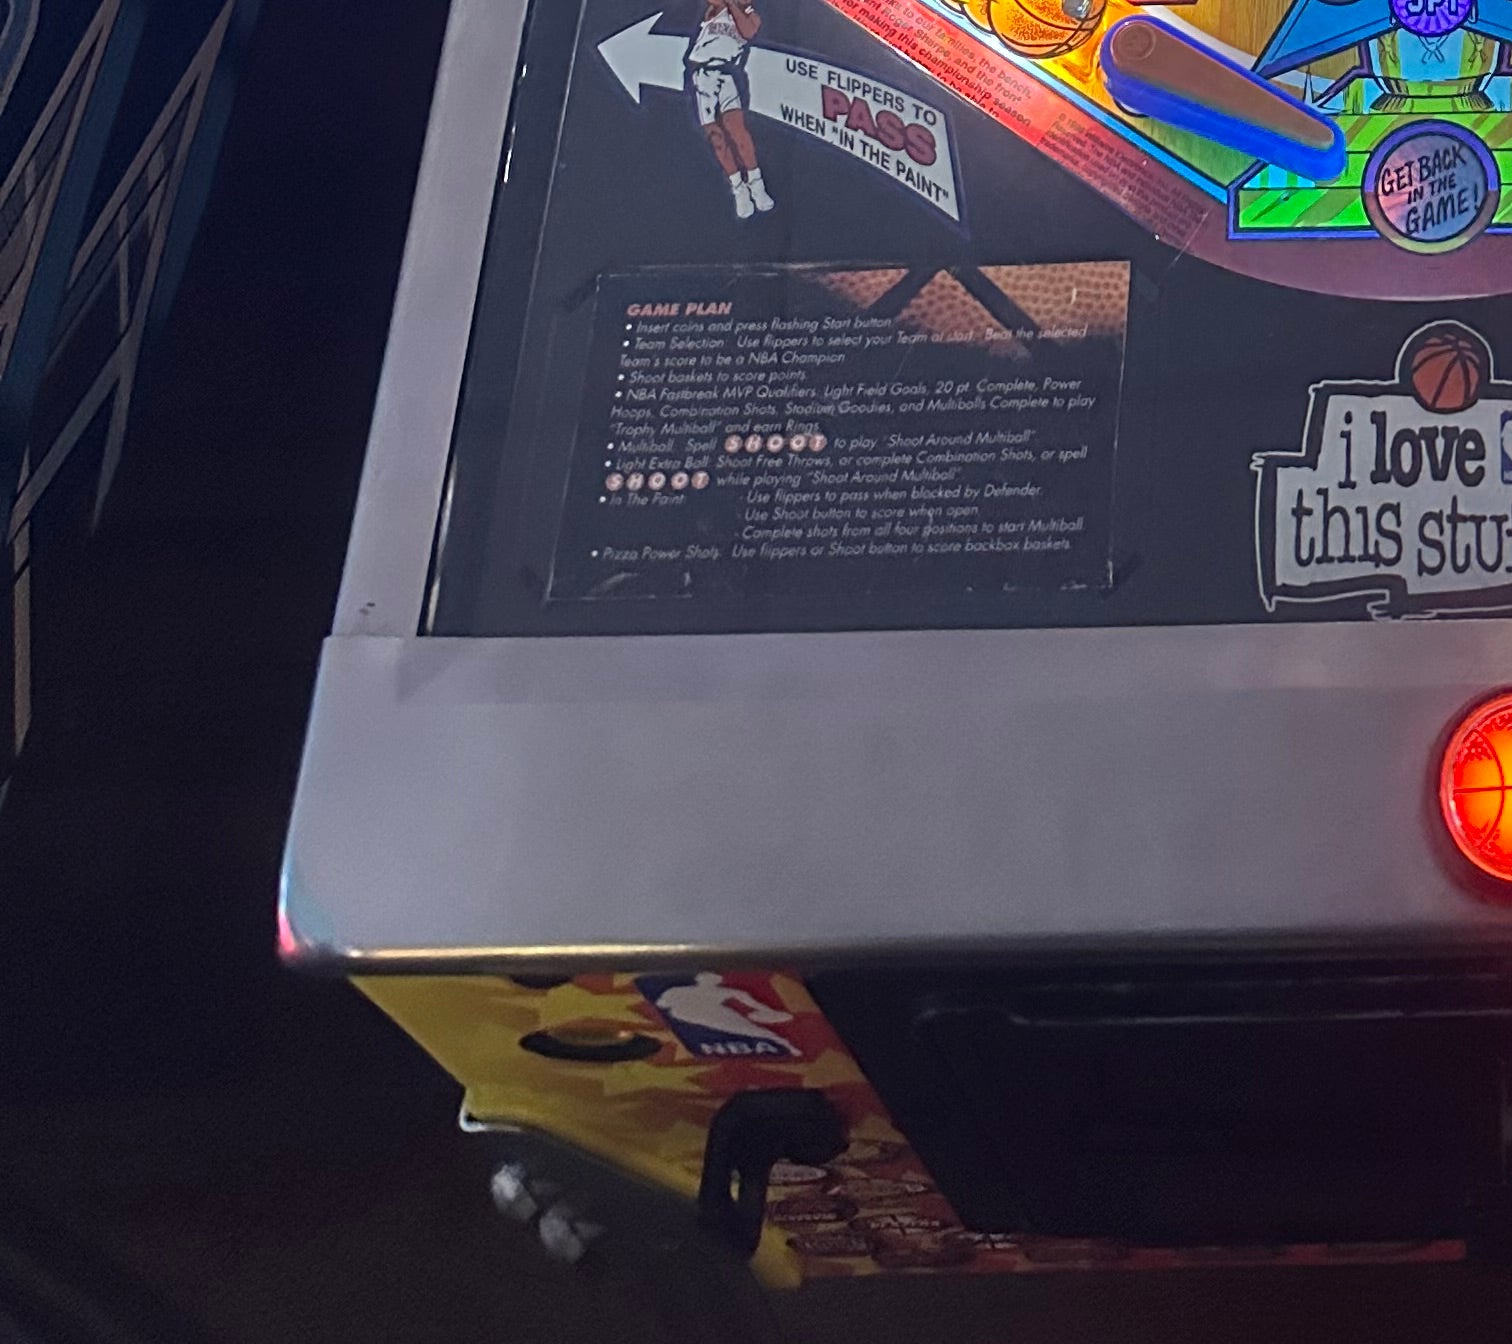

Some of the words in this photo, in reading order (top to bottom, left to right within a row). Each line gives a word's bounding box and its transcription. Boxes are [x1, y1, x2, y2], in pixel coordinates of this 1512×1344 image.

[786, 58, 818, 80] USE
[828, 70, 905, 113] FLIPPERS
[912, 103, 937, 126] TO
[821, 84, 938, 166] PASS
[780, 103, 826, 137] WHEN
[860, 139, 891, 171] THE
[896, 160, 949, 203] PAINT"
[1382, 160, 1415, 196] GET
[1417, 144, 1467, 182] BACK
[1406, 183, 1481, 236] GAME!
[1407, 185, 1424, 205] IN
[1429, 173, 1457, 196] THE
[626, 302, 680, 317] GAME
[684, 301, 733, 316] PLAN
[636, 321, 670, 333] Insert
[672, 321, 704, 333] coins
[708, 318, 732, 332] and
[734, 319, 767, 336] press
[771, 315, 819, 333] flashing
[822, 315, 851, 330] Start
[853, 317, 892, 329] button
[1338, 410, 1357, 490] i
[1370, 409, 1487, 488] love
[1291, 487, 1403, 570] this
[701, 1041, 780, 1056] NBA
